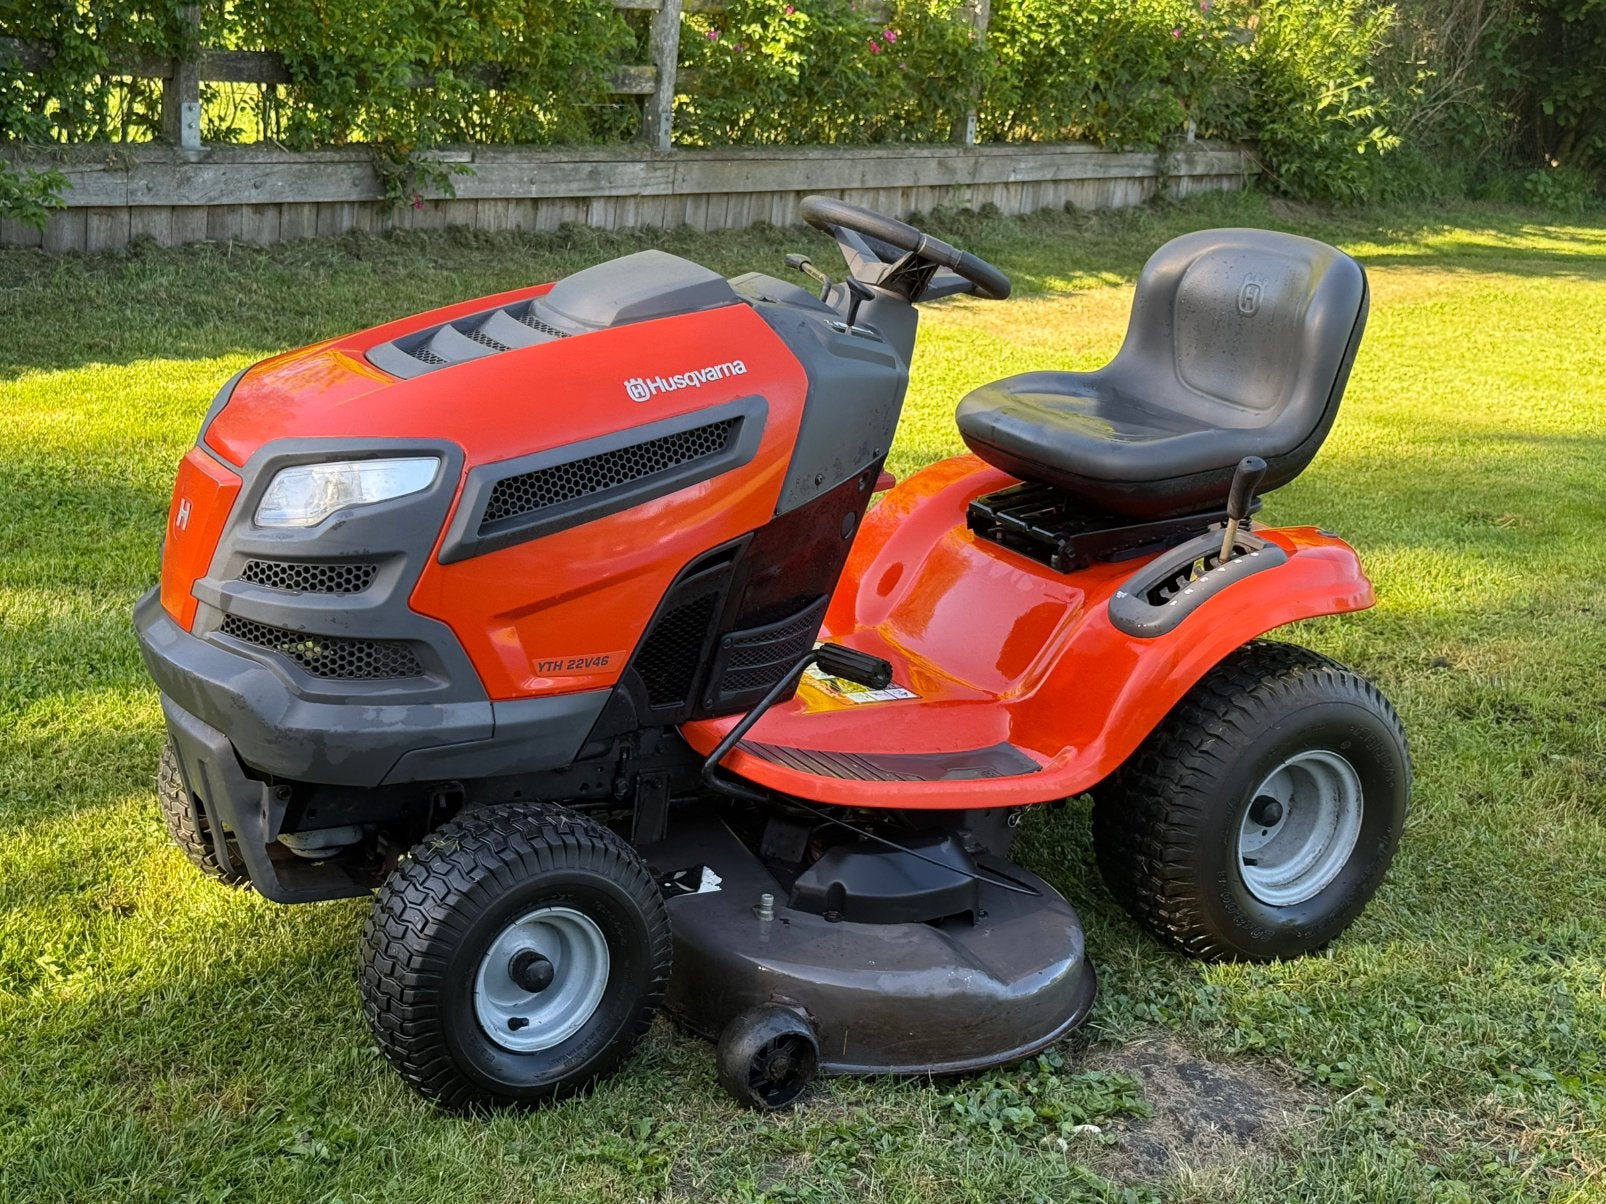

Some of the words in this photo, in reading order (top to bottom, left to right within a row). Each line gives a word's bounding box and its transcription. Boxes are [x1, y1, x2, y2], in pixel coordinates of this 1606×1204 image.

[645, 359, 748, 395] Husqvarna
[538, 660, 564, 673] YTH
[566, 655, 610, 671] 22V46
